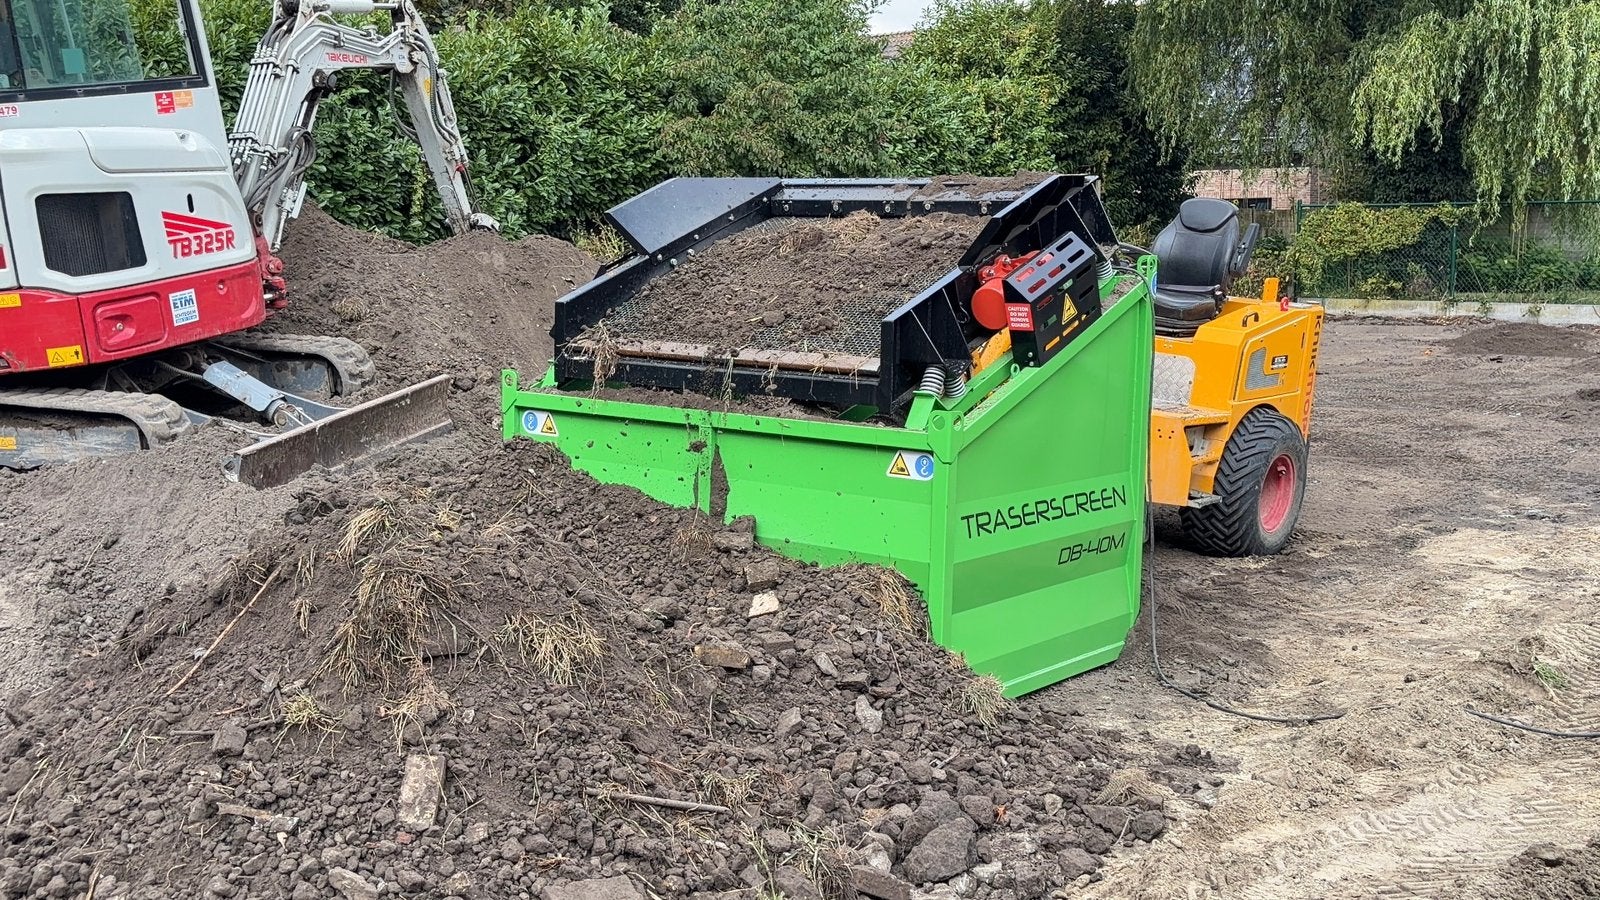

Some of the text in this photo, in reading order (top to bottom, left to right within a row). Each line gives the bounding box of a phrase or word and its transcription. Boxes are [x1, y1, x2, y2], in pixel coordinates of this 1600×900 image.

[326, 53, 368, 64] TAKEUCHI
[167, 229, 236, 259] TB325R
[172, 295, 195, 309] ETM
[960, 485, 1127, 539] TRASERSCREEN
[1057, 532, 1126, 565] DB-40M
